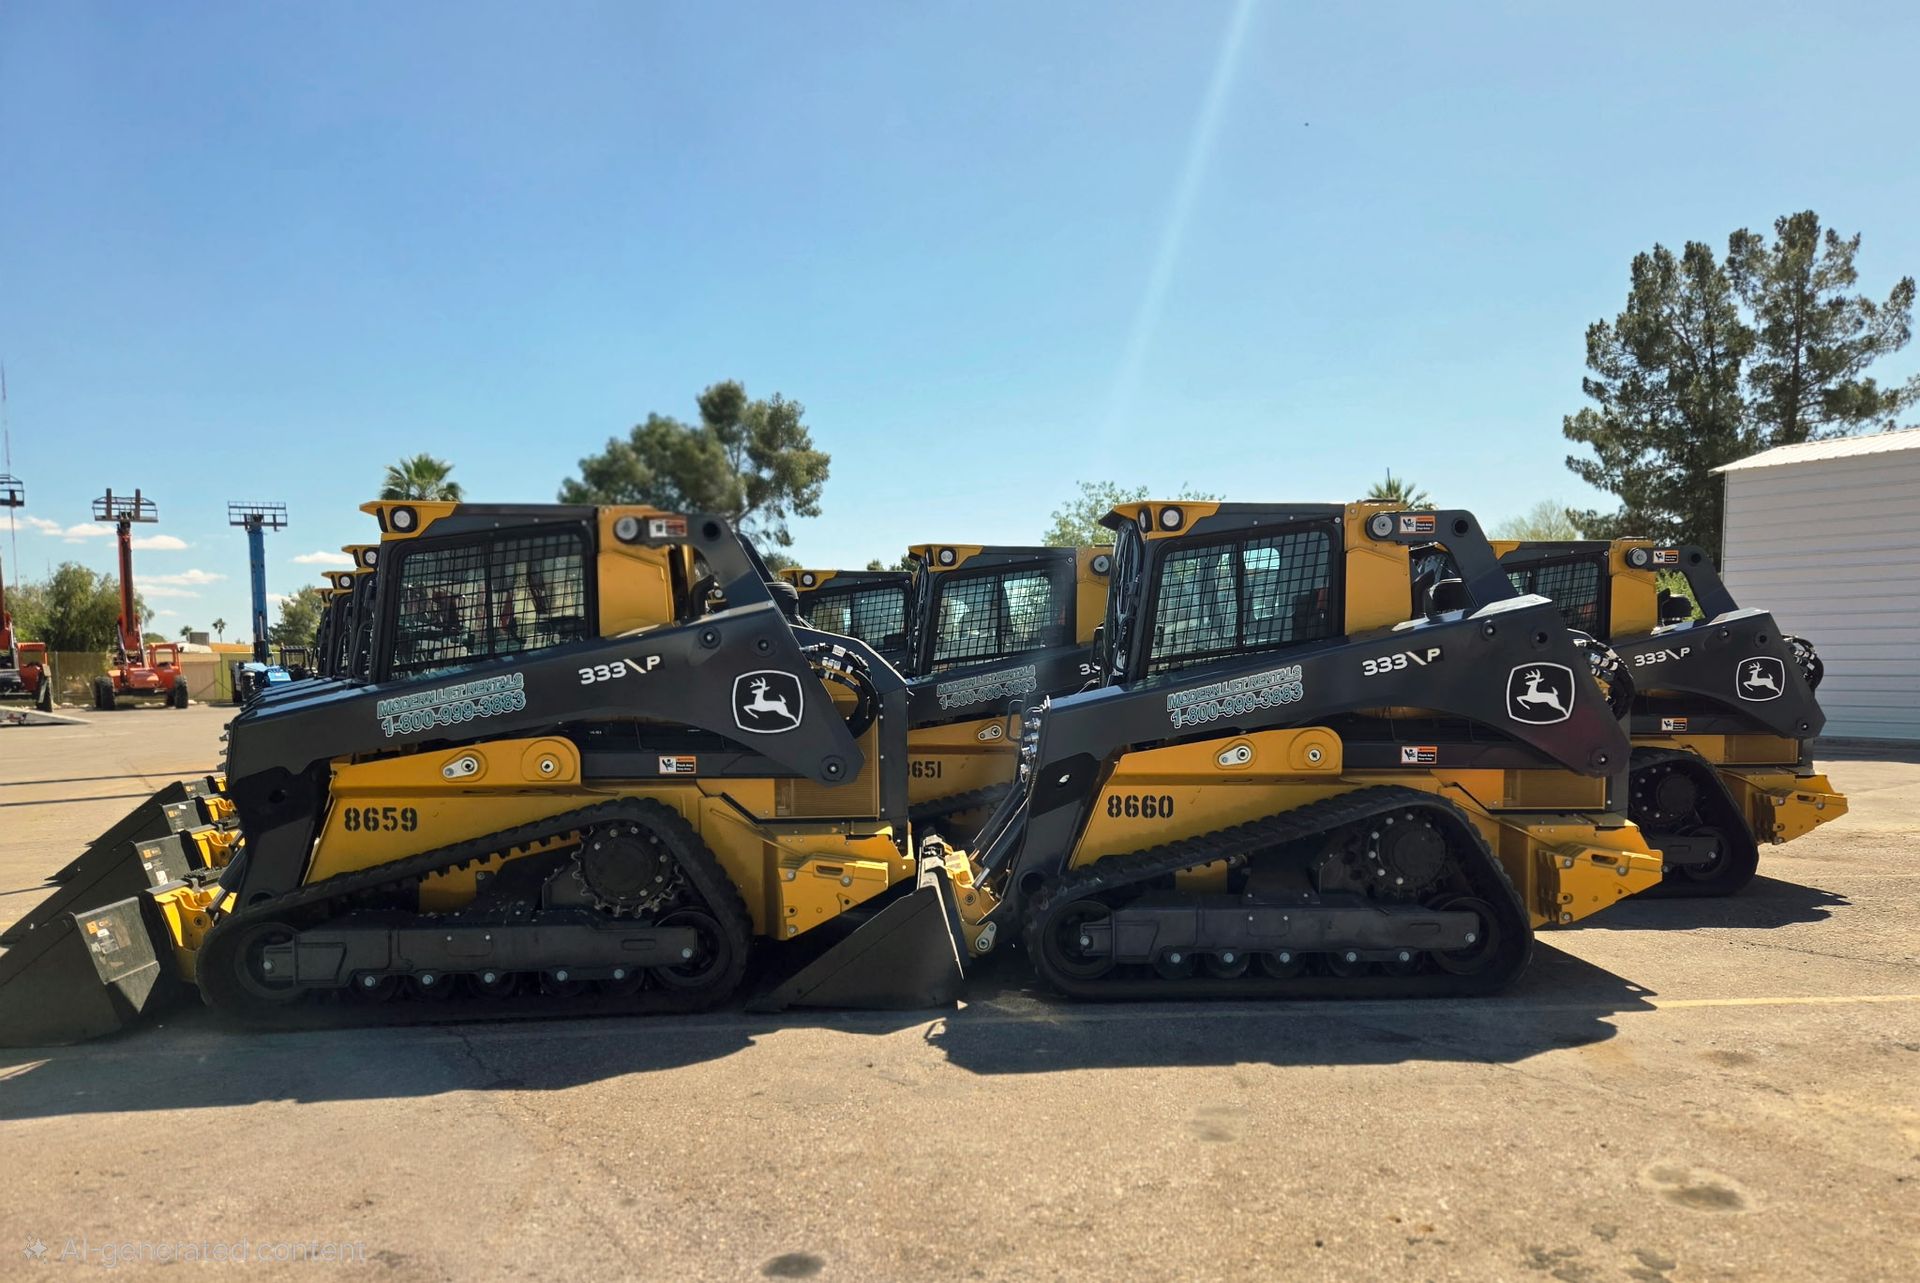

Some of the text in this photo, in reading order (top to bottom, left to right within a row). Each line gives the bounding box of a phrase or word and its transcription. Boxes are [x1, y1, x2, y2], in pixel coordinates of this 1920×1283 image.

[377, 672, 524, 719] MODERN LIFT RENTALS
[1167, 665, 1302, 712] MODERN LIFT RENTALS
[1171, 681, 1304, 729] 1-800-999-3883
[382, 689, 527, 737] 1-800-999-3883
[907, 760, 942, 778] 651
[344, 807, 418, 832] 8659
[1107, 794, 1174, 818] 8660
